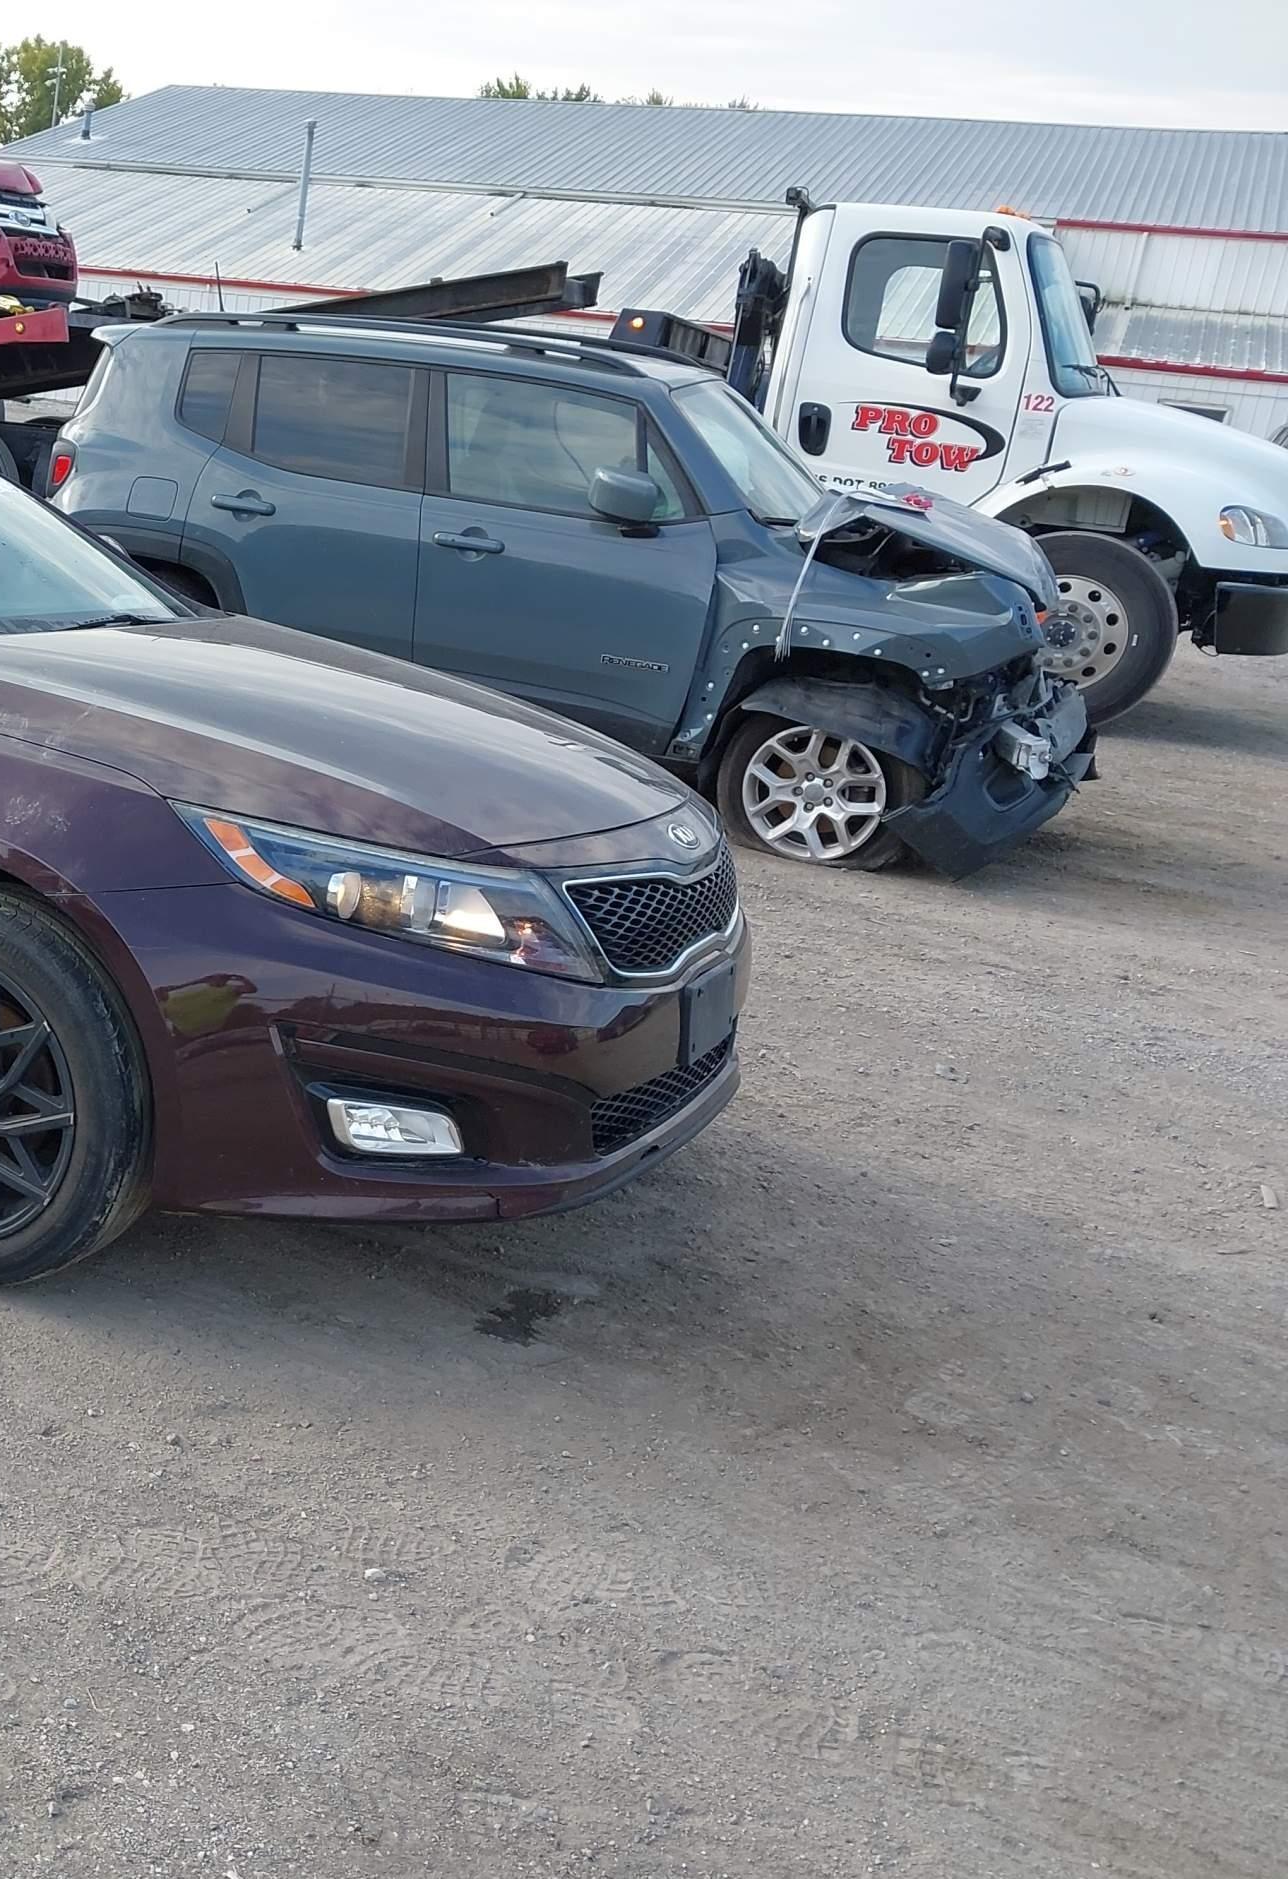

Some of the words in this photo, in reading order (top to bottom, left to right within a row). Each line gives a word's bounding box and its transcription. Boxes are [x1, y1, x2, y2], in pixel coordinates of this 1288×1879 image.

[1023, 393, 1055, 413] 122
[851, 404, 939, 439] PRO
[888, 437, 981, 472] TOW
[600, 653, 669, 673] RENEGADE
